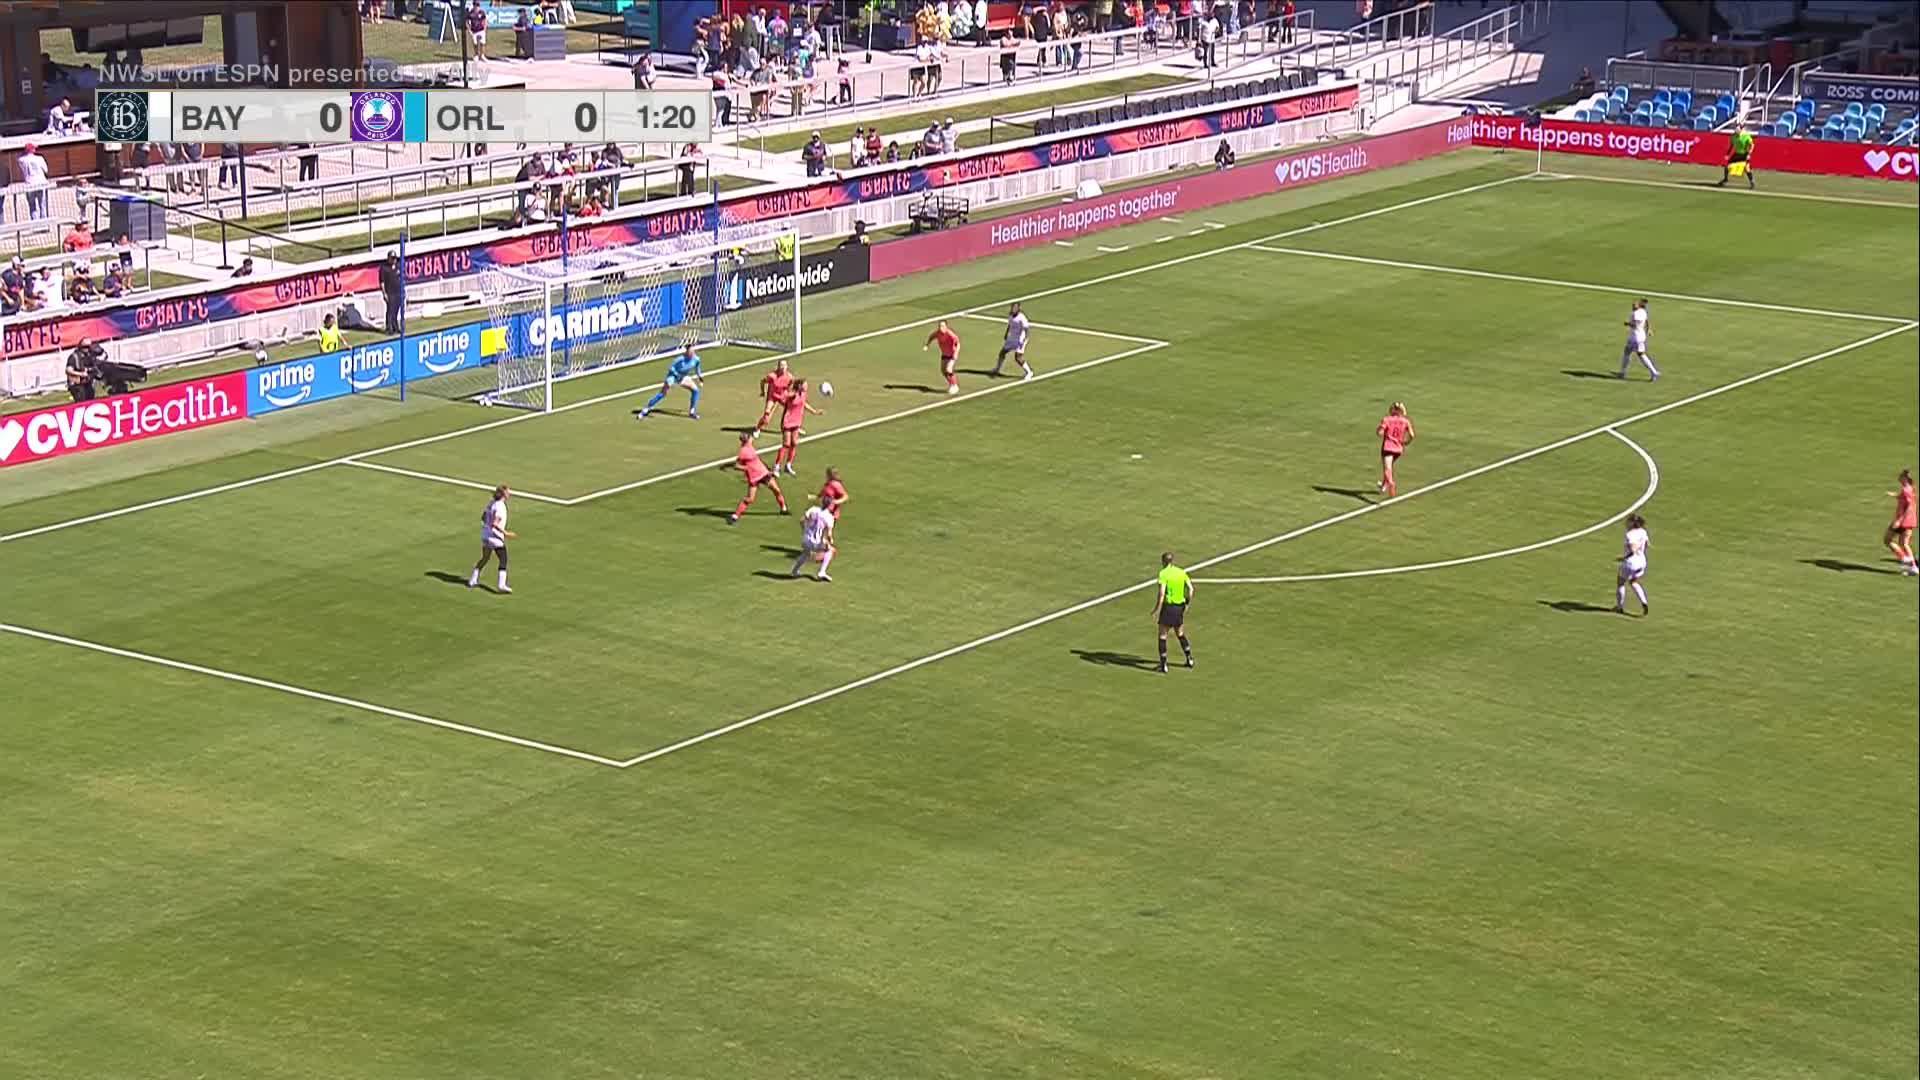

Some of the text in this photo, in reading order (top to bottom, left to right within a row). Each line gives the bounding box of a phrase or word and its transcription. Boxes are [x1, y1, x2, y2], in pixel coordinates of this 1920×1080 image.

[1827, 85, 1865, 99] ROSS
[1447, 120, 1695, 156] Healthier happens together
[874, 175, 894, 194] BAY
[991, 189, 1177, 246] Healthier happens together
[424, 250, 449, 276] BAY
[294, 271, 342, 299] BAY FC
[156, 297, 209, 326] BAY FC
[4, 323, 61, 354] BAY FC
[418, 330, 470, 363] prime
[340, 345, 394, 380] prime
[259, 361, 315, 397] prime
